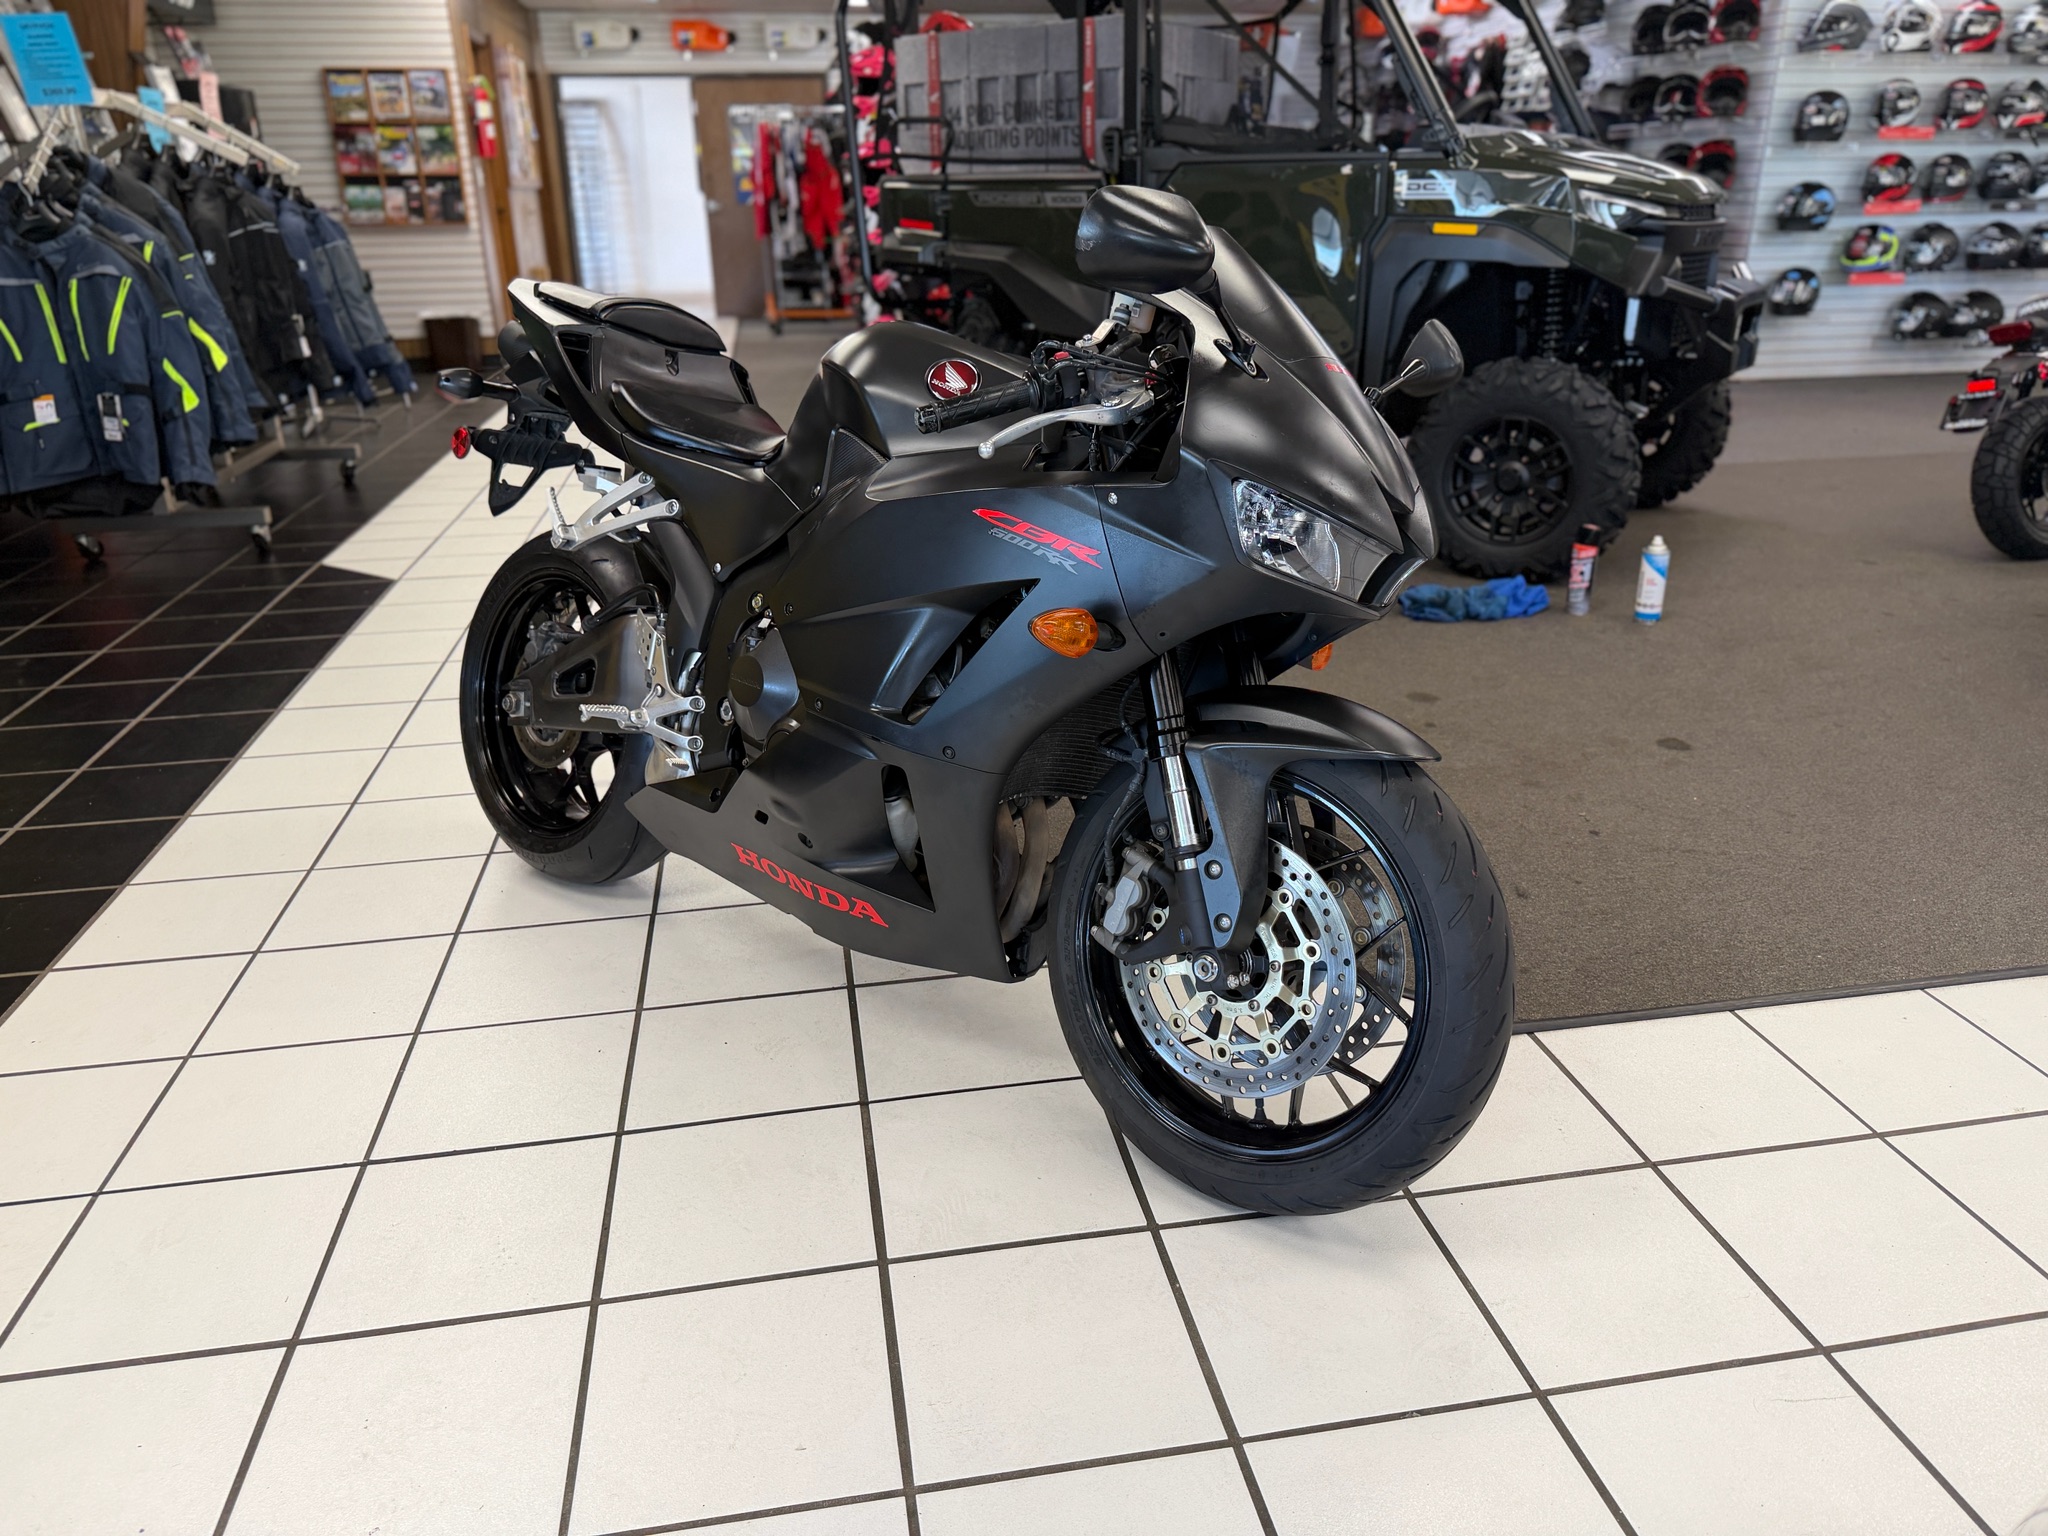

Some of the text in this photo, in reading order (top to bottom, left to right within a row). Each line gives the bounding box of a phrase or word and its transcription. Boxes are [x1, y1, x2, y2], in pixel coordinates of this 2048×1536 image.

[931, 379, 961, 396] HONDA
[972, 508, 1104, 570] CBR
[730, 842, 889, 928] HONDA
